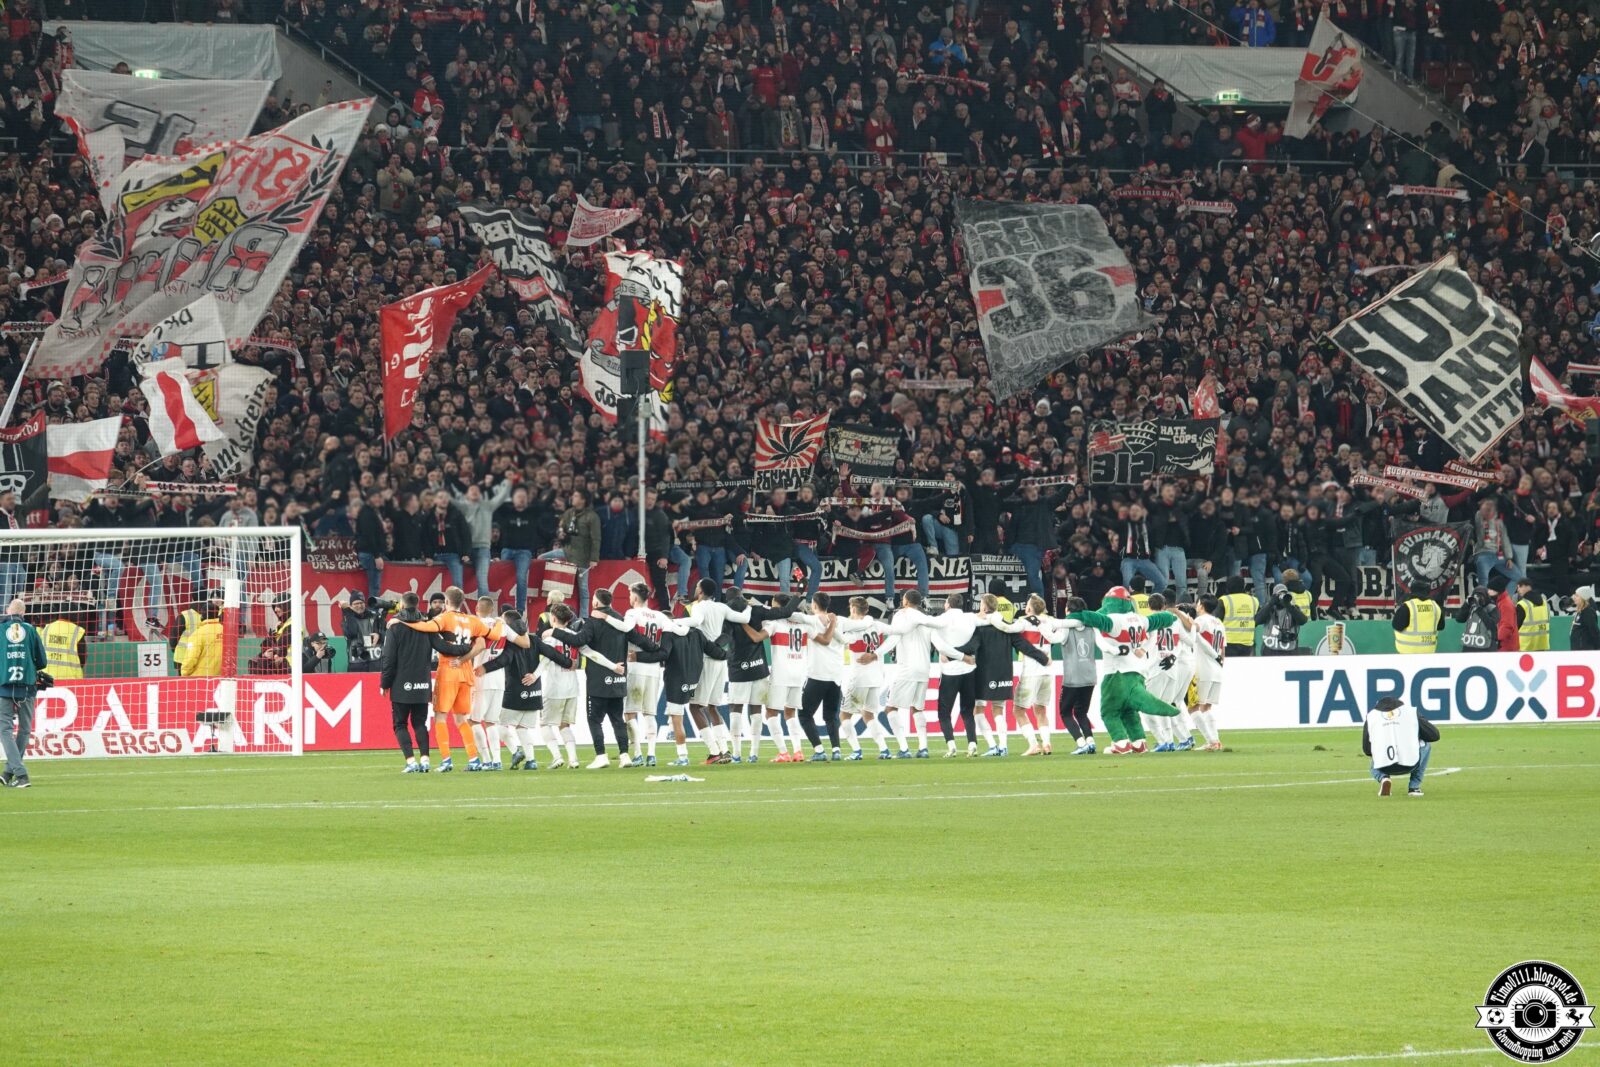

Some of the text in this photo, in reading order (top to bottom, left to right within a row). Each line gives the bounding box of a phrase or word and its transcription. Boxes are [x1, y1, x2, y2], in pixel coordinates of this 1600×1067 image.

[1160, 425, 1187, 435] HATE
[1173, 433, 1198, 444] COPS
[1088, 451, 1156, 486] 312
[312, 561, 335, 570] UMS
[789, 628, 802, 652] 18
[1158, 628, 1174, 651] 20
[143, 653, 162, 667] 35
[750, 659, 763, 668] JAKO
[413, 682, 429, 690] JAKO
[1284, 665, 1498, 724] TARGO
[25, 731, 183, 756] RGO ERGO
